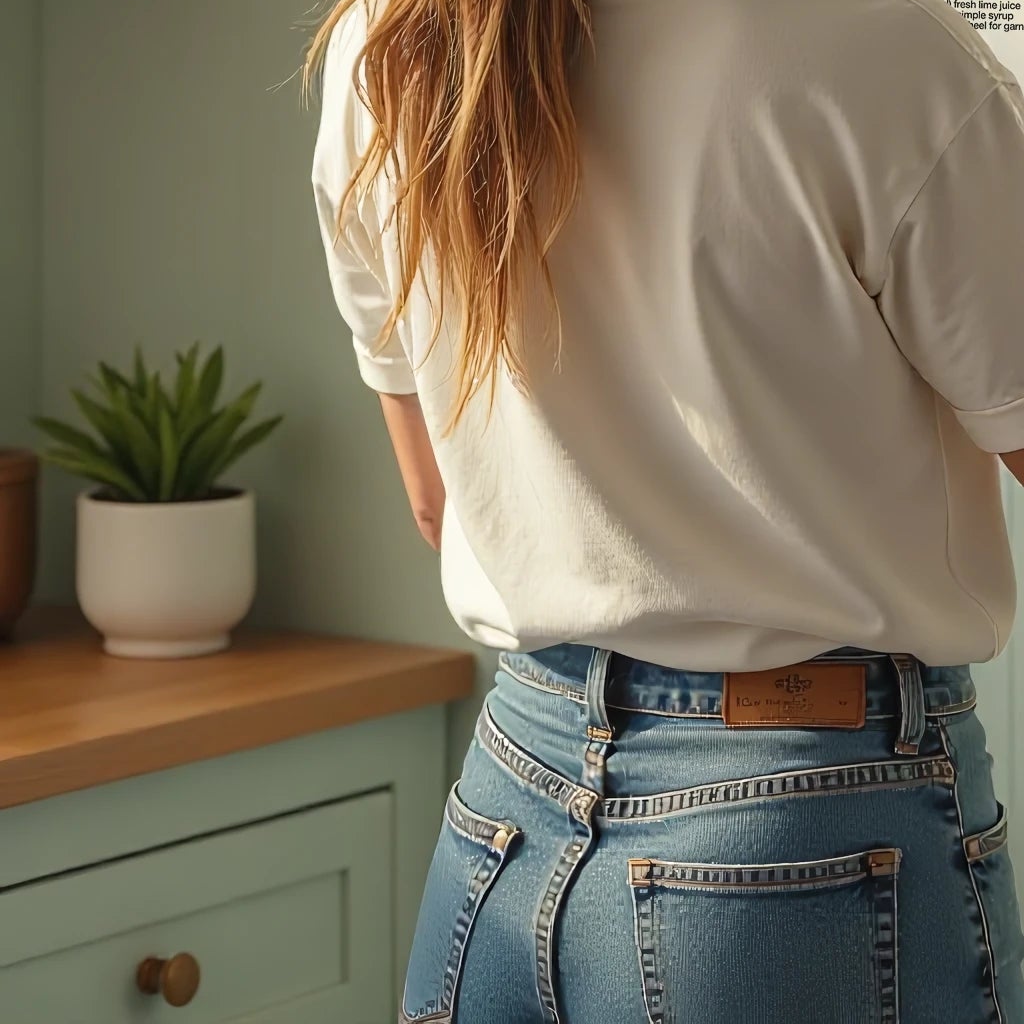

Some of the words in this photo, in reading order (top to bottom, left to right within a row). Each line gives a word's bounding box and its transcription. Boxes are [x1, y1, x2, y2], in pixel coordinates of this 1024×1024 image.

[954, 0, 976, 9] fresh
[978, 0, 998, 9] lime
[999, 1, 1021, 11] juice
[988, 12, 1014, 21] syrup
[989, 22, 1002, 30] for
